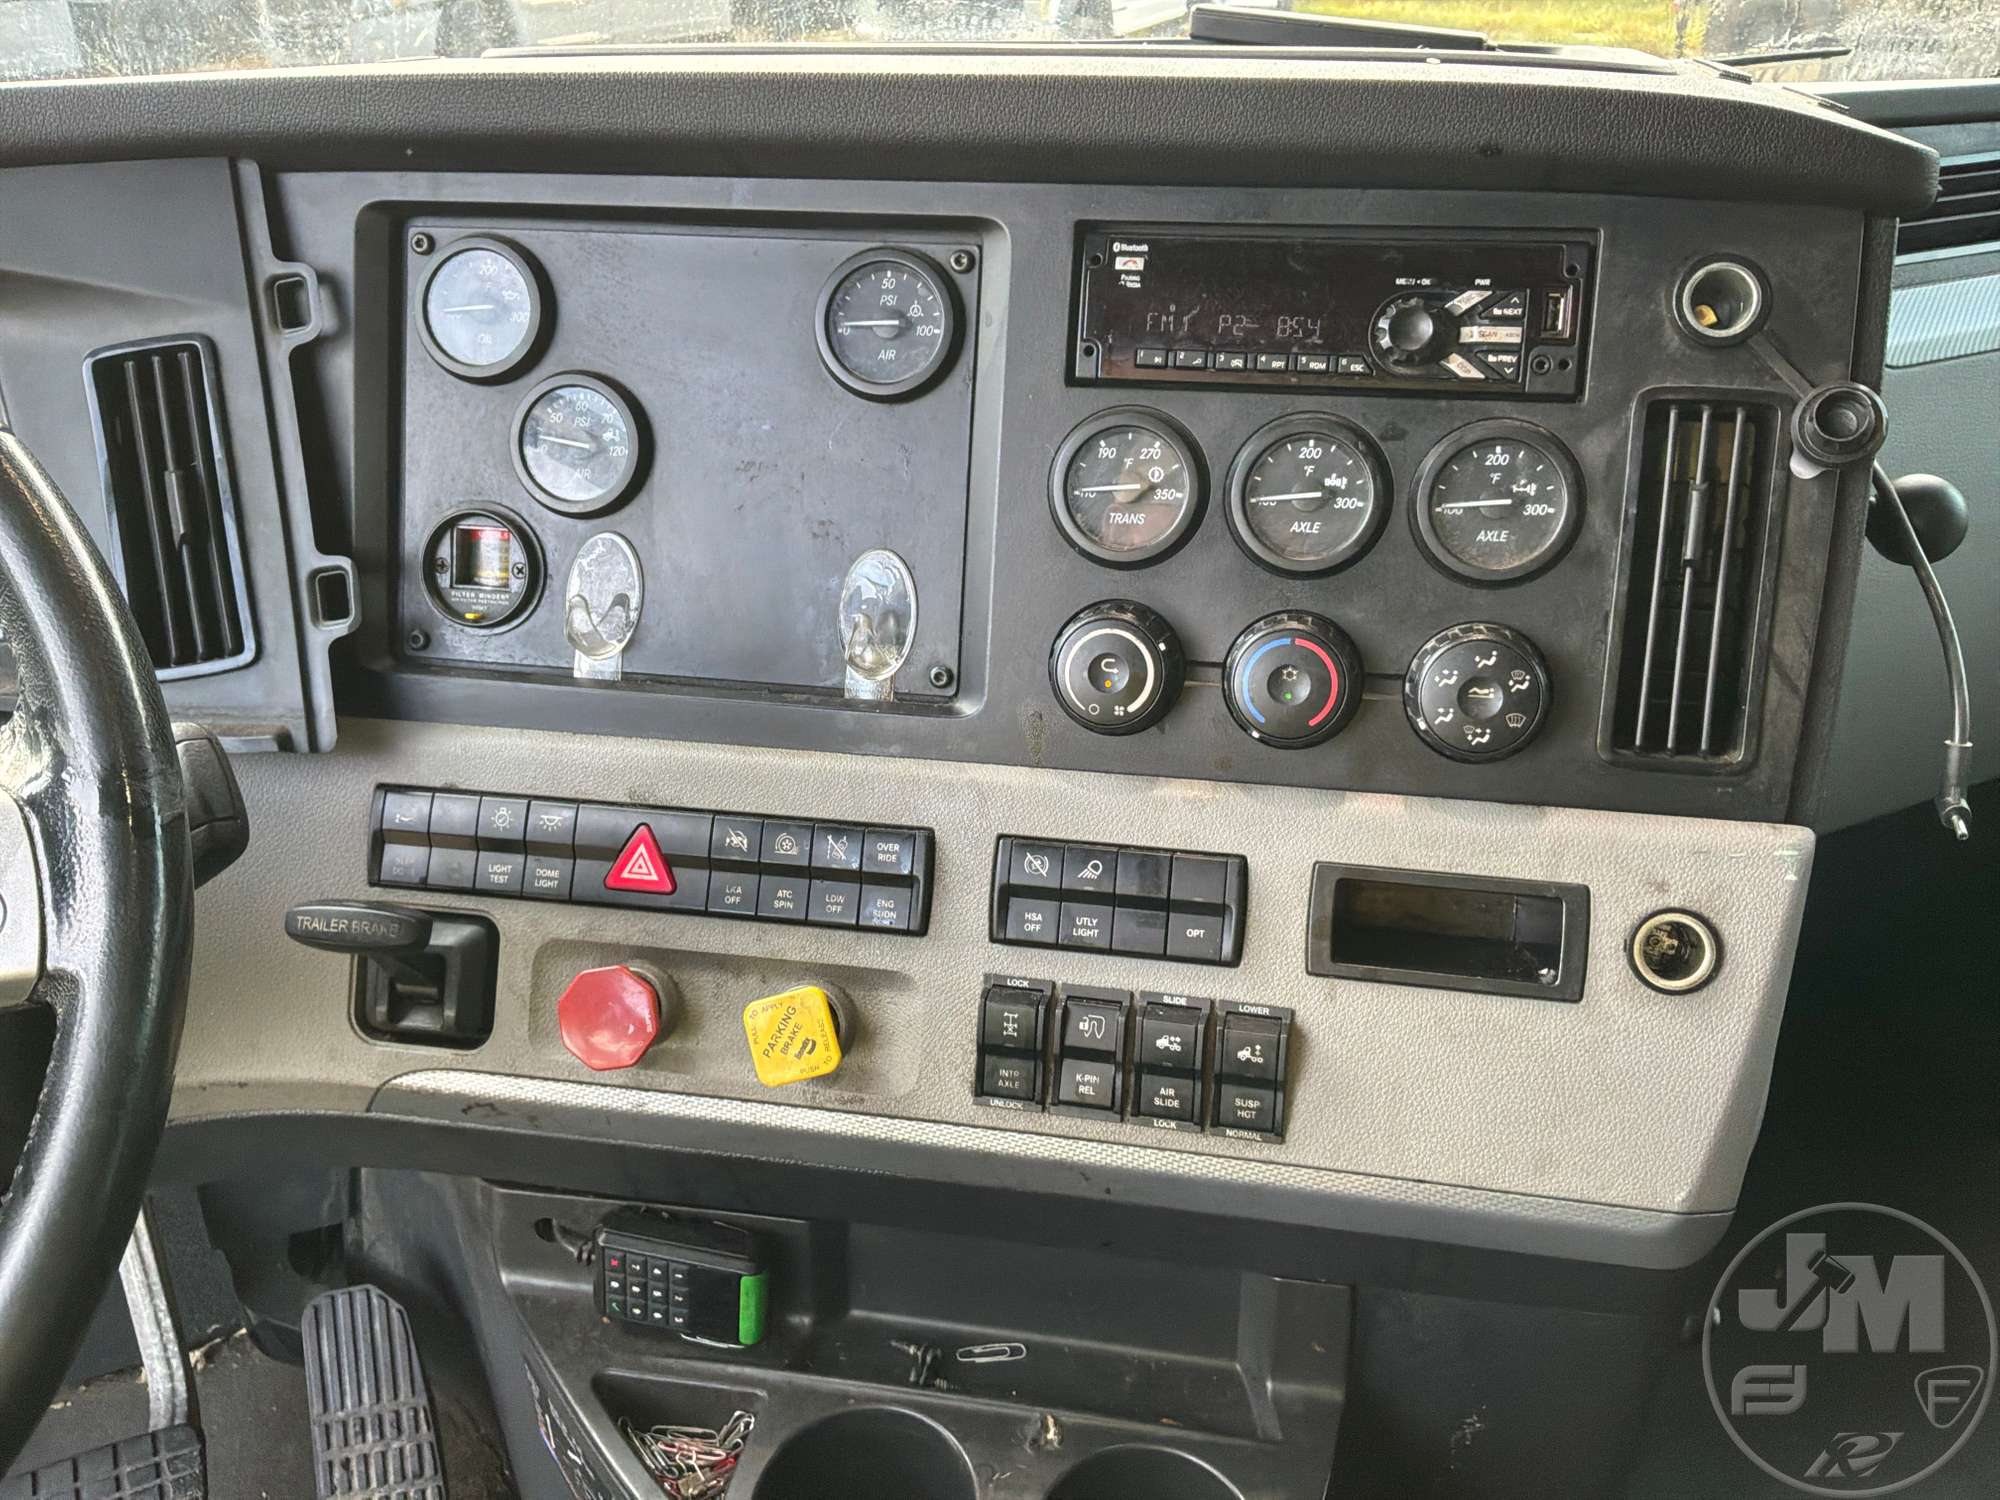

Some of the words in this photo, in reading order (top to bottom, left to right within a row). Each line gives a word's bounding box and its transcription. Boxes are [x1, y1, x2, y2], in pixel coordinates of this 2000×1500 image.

[881, 278, 896, 290] 50
[880, 295, 897, 306] PSI
[1503, 308, 1522, 316] NEXT
[916, 325, 933, 337] 100
[878, 349, 896, 361] AIR
[1497, 355, 1518, 363] PREV
[1271, 361, 1287, 371] RPT
[1309, 362, 1328, 371] RDM
[1350, 364, 1365, 373] ESC
[549, 413, 563, 424] 50
[574, 417, 591, 428] PSI
[609, 446, 625, 457] 120
[1098, 447, 1117, 459] 190
[1139, 448, 1161, 460] 270
[1298, 447, 1322, 459] 200
[1485, 454, 1510, 466] 200
[1153, 489, 1176, 500] 350
[1333, 497, 1357, 509] 300
[1522, 504, 1547, 516] 300
[1109, 512, 1146, 525] TRANS
[1290, 521, 1322, 533] AXLE
[1476, 530, 1510, 543] AXLE
[876, 842, 900, 853] OVER
[877, 853, 897, 863] RIDE
[488, 864, 512, 875] LIGHT
[536, 867, 560, 879] DOME
[489, 874, 510, 885] TEST
[534, 878, 559, 889] LIGHT
[776, 889, 793, 900] ATC
[825, 894, 845, 904] LOW
[724, 895, 742, 906] OFF
[773, 900, 794, 911] SPIN
[876, 898, 895, 909] ENG
[825, 904, 843, 914] OFF
[1024, 912, 1043, 922] HSA
[1076, 916, 1098, 927] UTLY
[296, 915, 349, 934] TRAILER
[1024, 922, 1042, 933] OFF
[1072, 927, 1100, 939] LIGHT
[1186, 928, 1206, 939] OPT
[1007, 978, 1030, 988] LOCK
[1162, 995, 1188, 1006] SLIDE
[1238, 1004, 1270, 1016] LOWER
[762, 1005, 797, 1058] PARKING
[780, 1022, 803, 1056] BRAKE
[998, 1079, 1021, 1089] AXLE
[1075, 1073, 1100, 1085] K-PIN
[1078, 1085, 1096, 1096] REL
[1159, 1087, 1176, 1097] AIR
[989, 1098, 1024, 1110] UNLOCK
[1153, 1097, 1181, 1109] SLIDE
[1234, 1098, 1261, 1109] SUSP
[1236, 1110, 1257, 1120] HGT
[1153, 1119, 1177, 1130] LOCK
[1225, 1129, 1263, 1142] NORMAL
